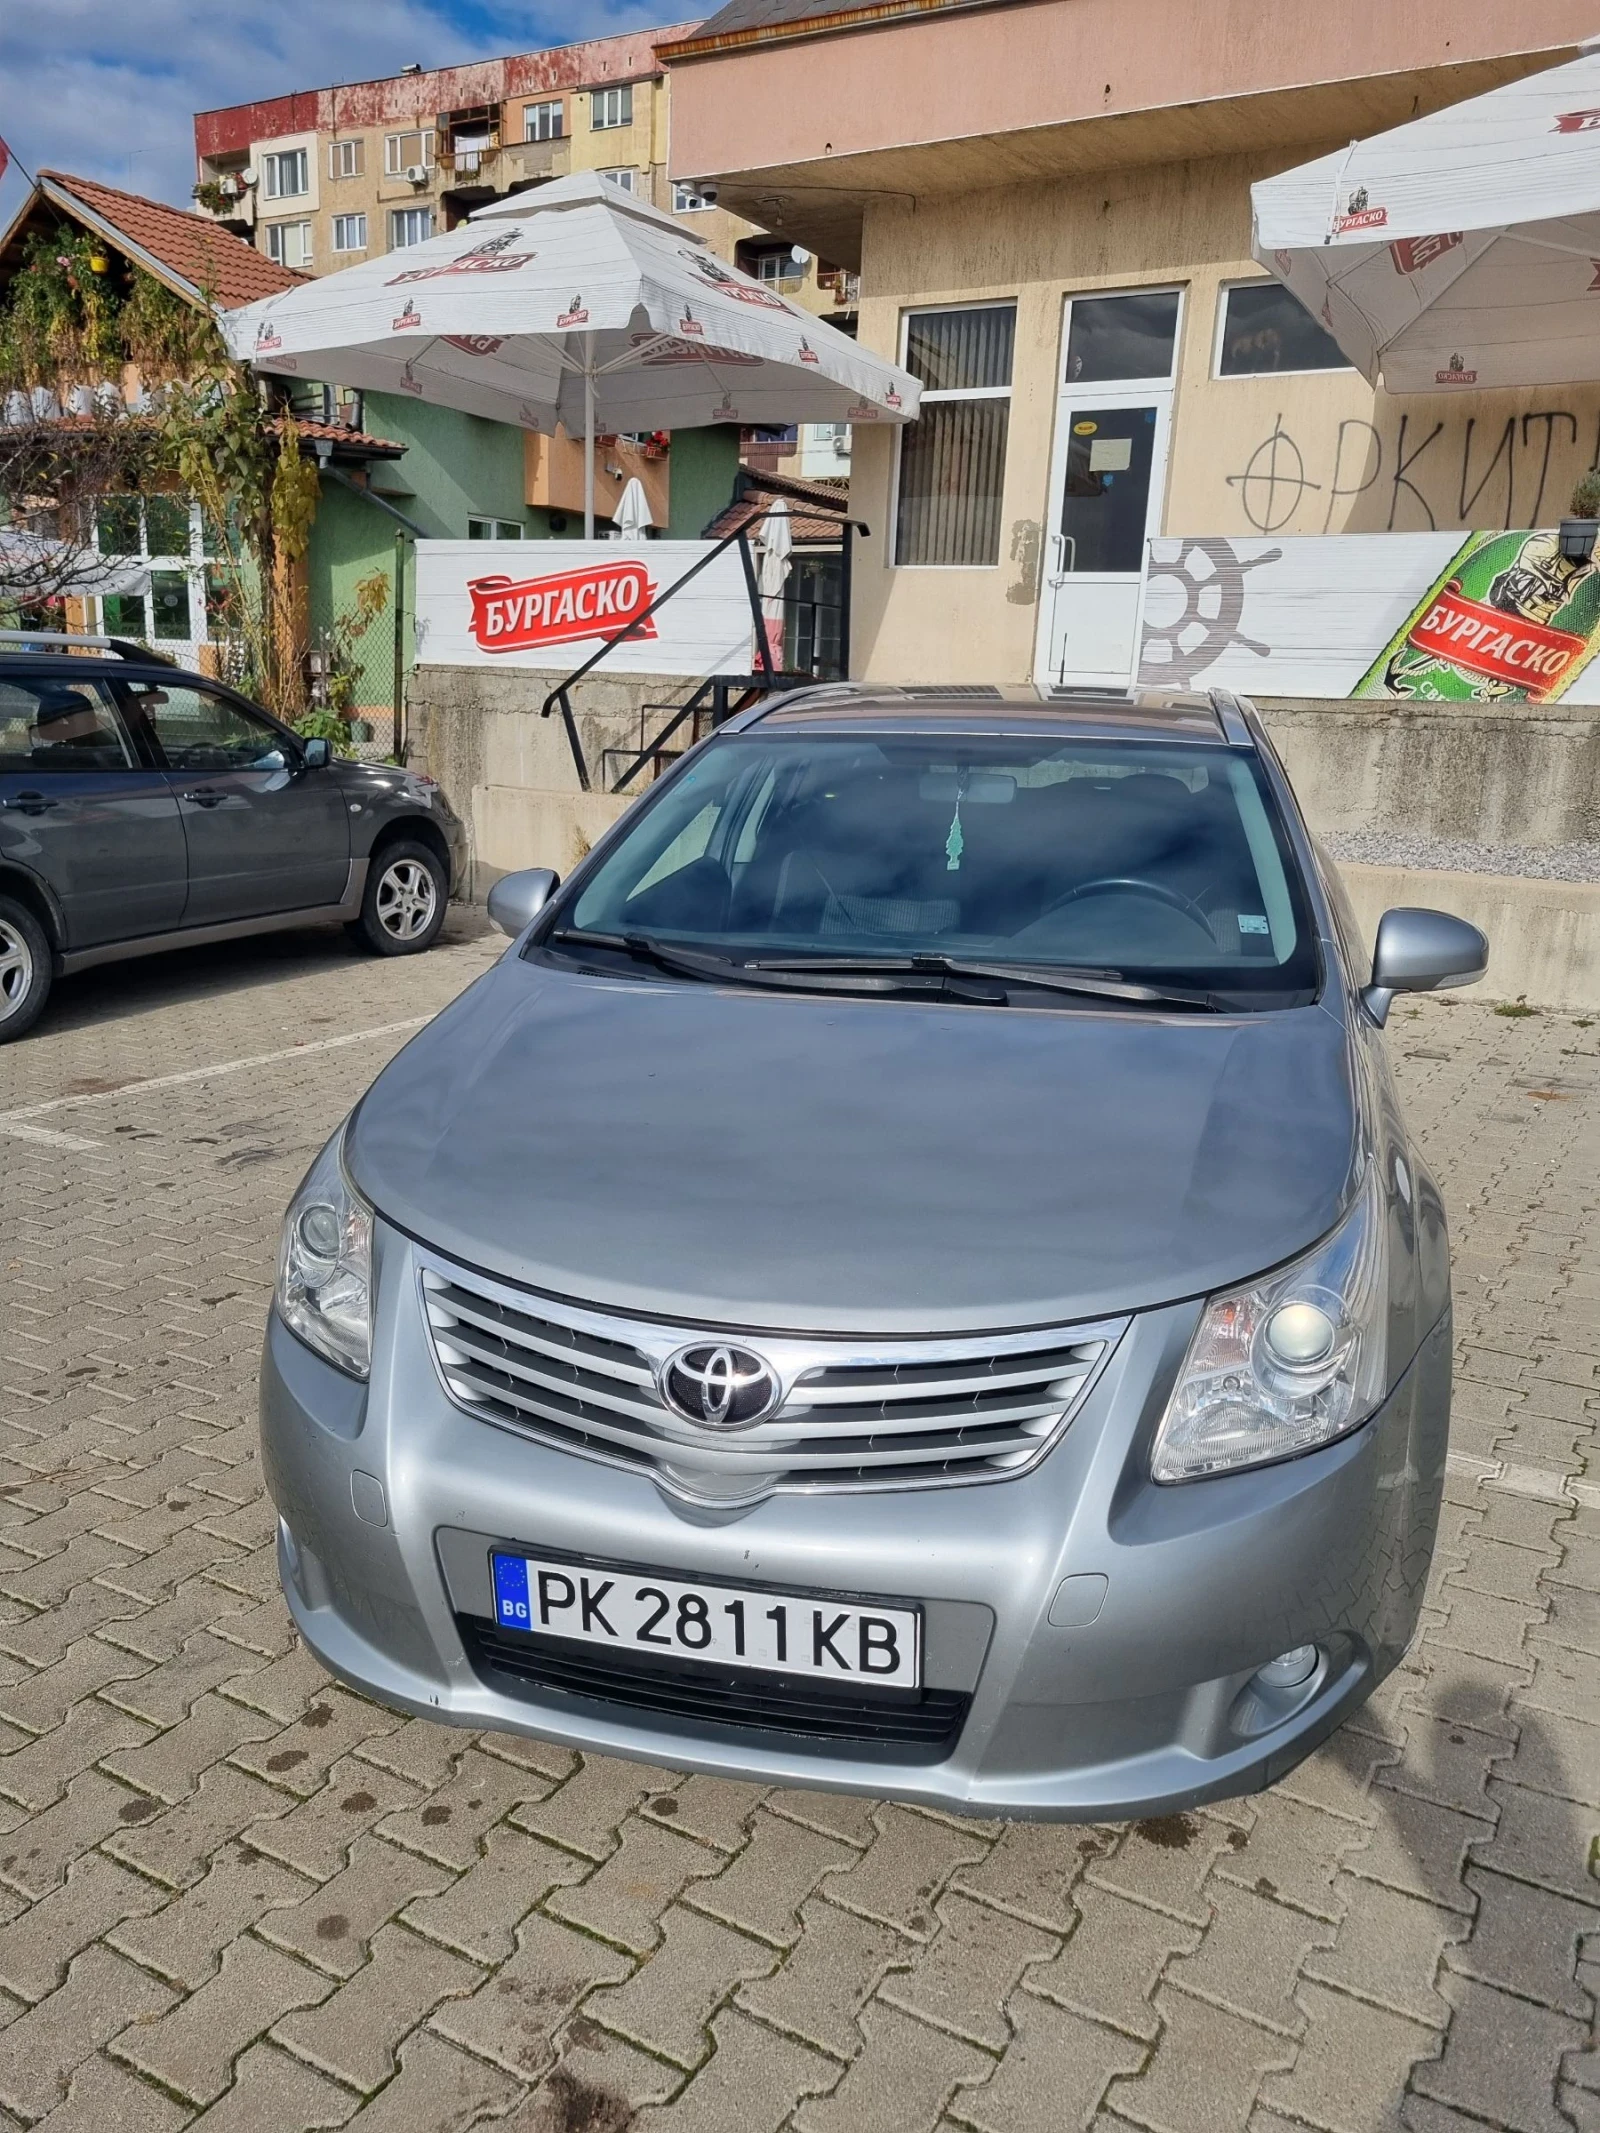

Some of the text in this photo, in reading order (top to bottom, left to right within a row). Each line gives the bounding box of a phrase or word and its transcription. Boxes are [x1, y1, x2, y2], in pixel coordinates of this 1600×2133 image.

[486, 575, 639, 637] БУРГАСКО
[1420, 605, 1571, 675] БУРГАСКО
[502, 1600, 527, 1619] BG
[537, 1570, 901, 1675] PK 2811 KB
